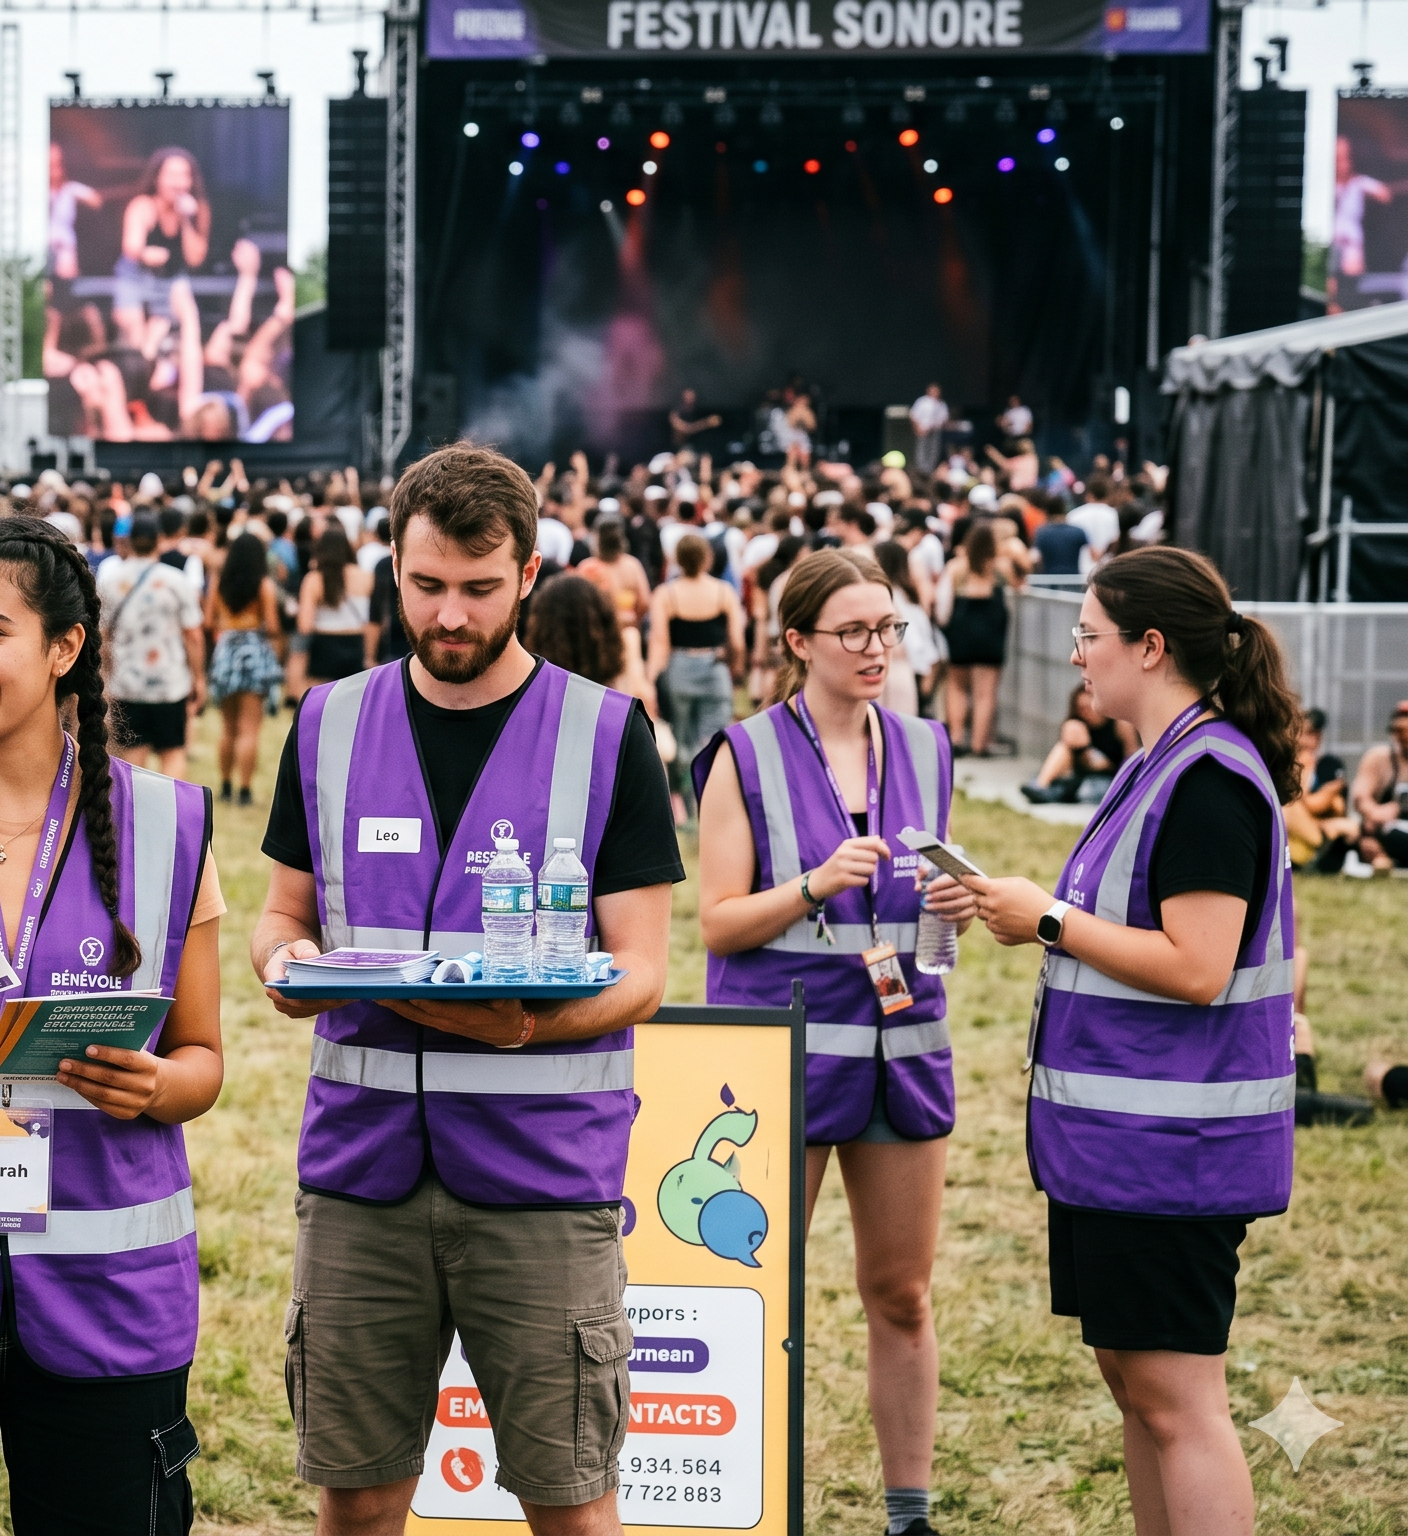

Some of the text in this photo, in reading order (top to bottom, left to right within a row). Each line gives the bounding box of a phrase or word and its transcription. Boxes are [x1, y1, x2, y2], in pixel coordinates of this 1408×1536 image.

[606, 0, 1022, 50] FESTIVAL SONORE
[375, 829, 400, 842] Leo
[50, 968, 123, 990] BÉNÉVOLE
[639, 1484, 677, 1502] 722
[683, 1486, 722, 1503] 883
